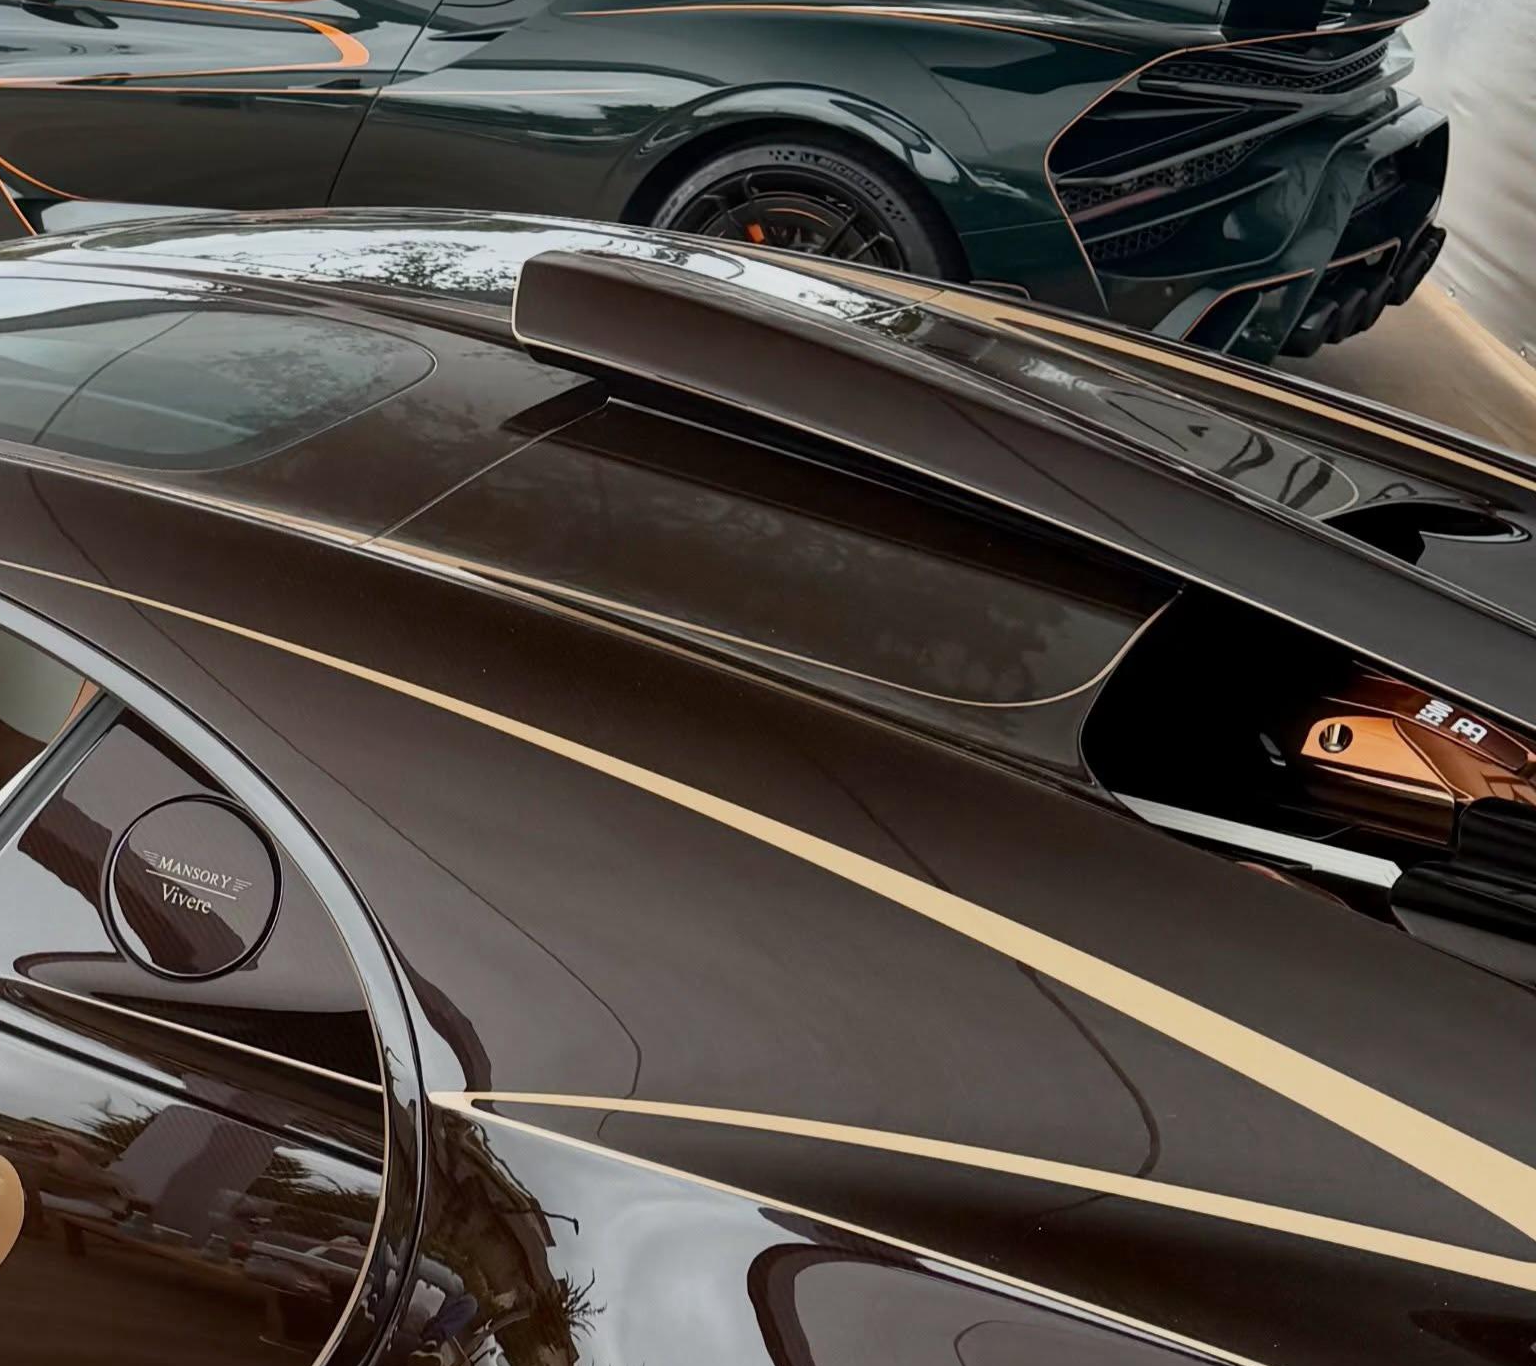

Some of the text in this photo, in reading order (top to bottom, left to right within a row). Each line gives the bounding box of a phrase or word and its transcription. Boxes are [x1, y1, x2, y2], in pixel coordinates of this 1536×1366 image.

[1414, 698, 1455, 728] 1500
[157, 855, 233, 891] MANSORY
[161, 882, 213, 915] Vivere
